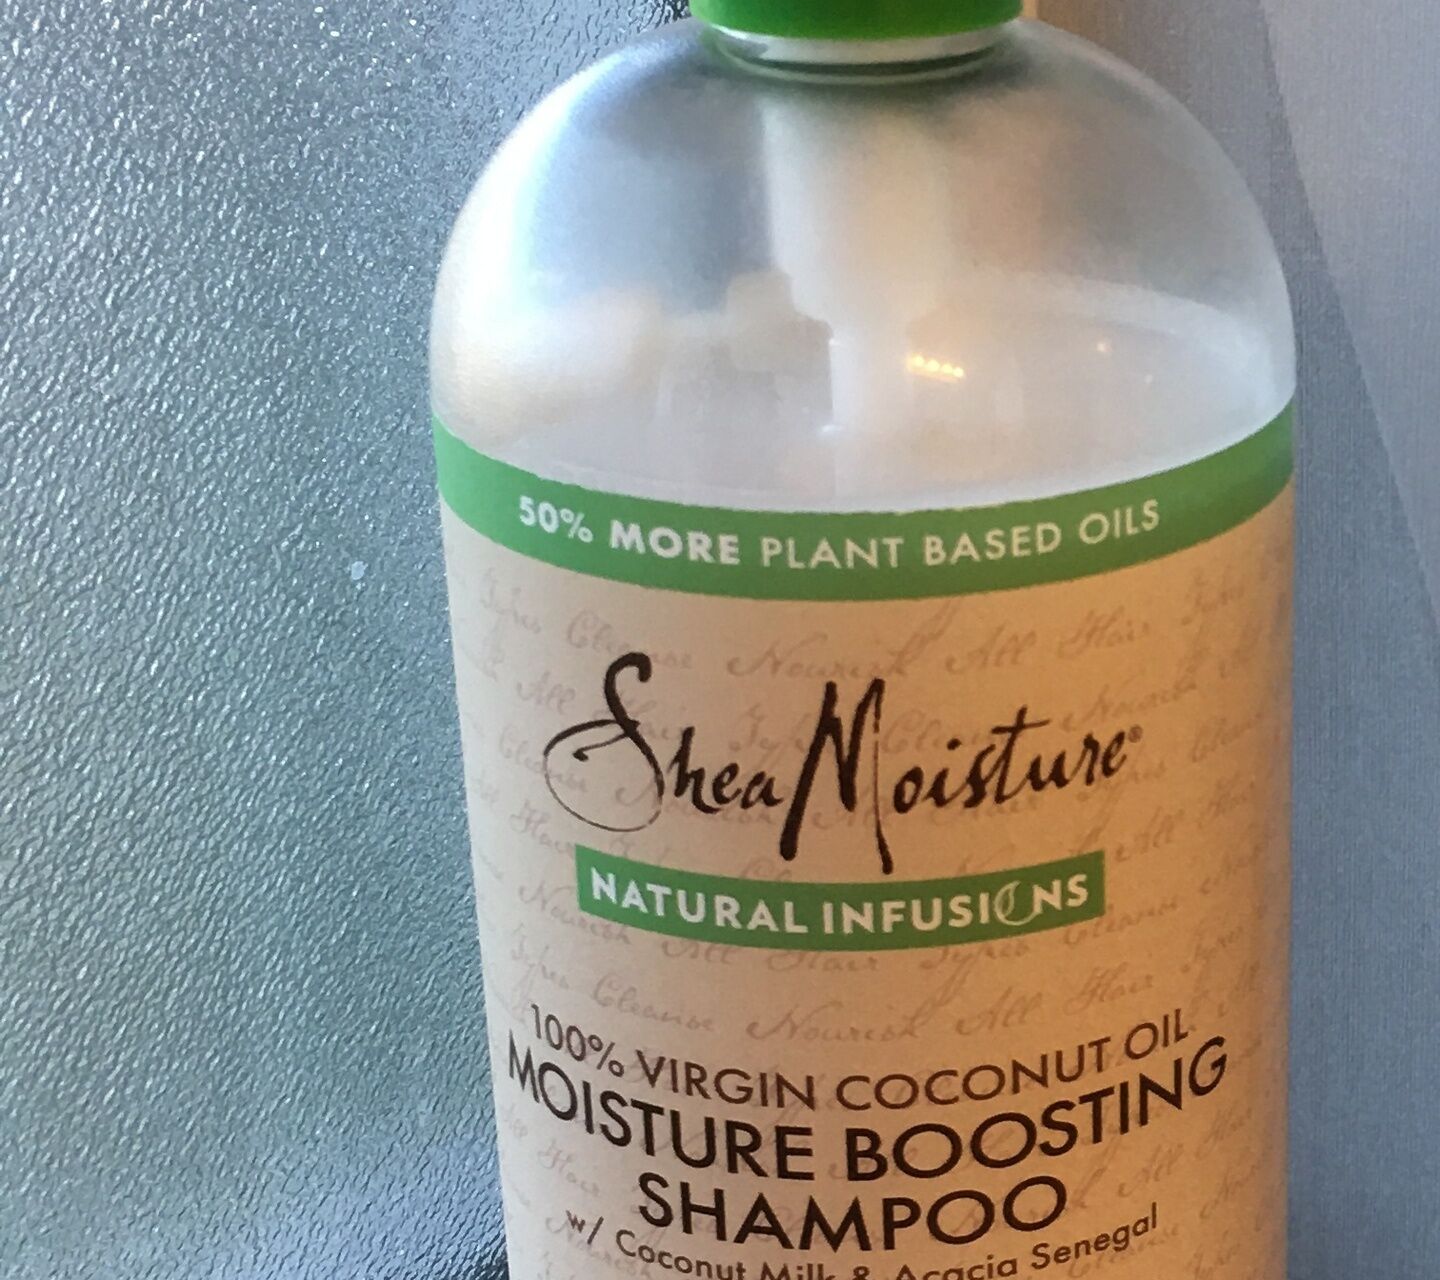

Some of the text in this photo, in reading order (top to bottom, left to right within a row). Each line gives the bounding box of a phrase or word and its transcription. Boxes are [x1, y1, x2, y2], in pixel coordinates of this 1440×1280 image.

[519, 495, 1160, 570] 50% MORE PLANT BASED OILS
[591, 867, 808, 933] NATURAL
[529, 1004, 1189, 1110] 100% VIRGIN COCONUT OIL
[508, 1031, 1228, 1182] MOISTURE BOOSTING
[565, 1209, 601, 1248] w/
[1033, 1204, 1158, 1267] Senegal
[637, 1171, 1069, 1252] SHAMPOO
